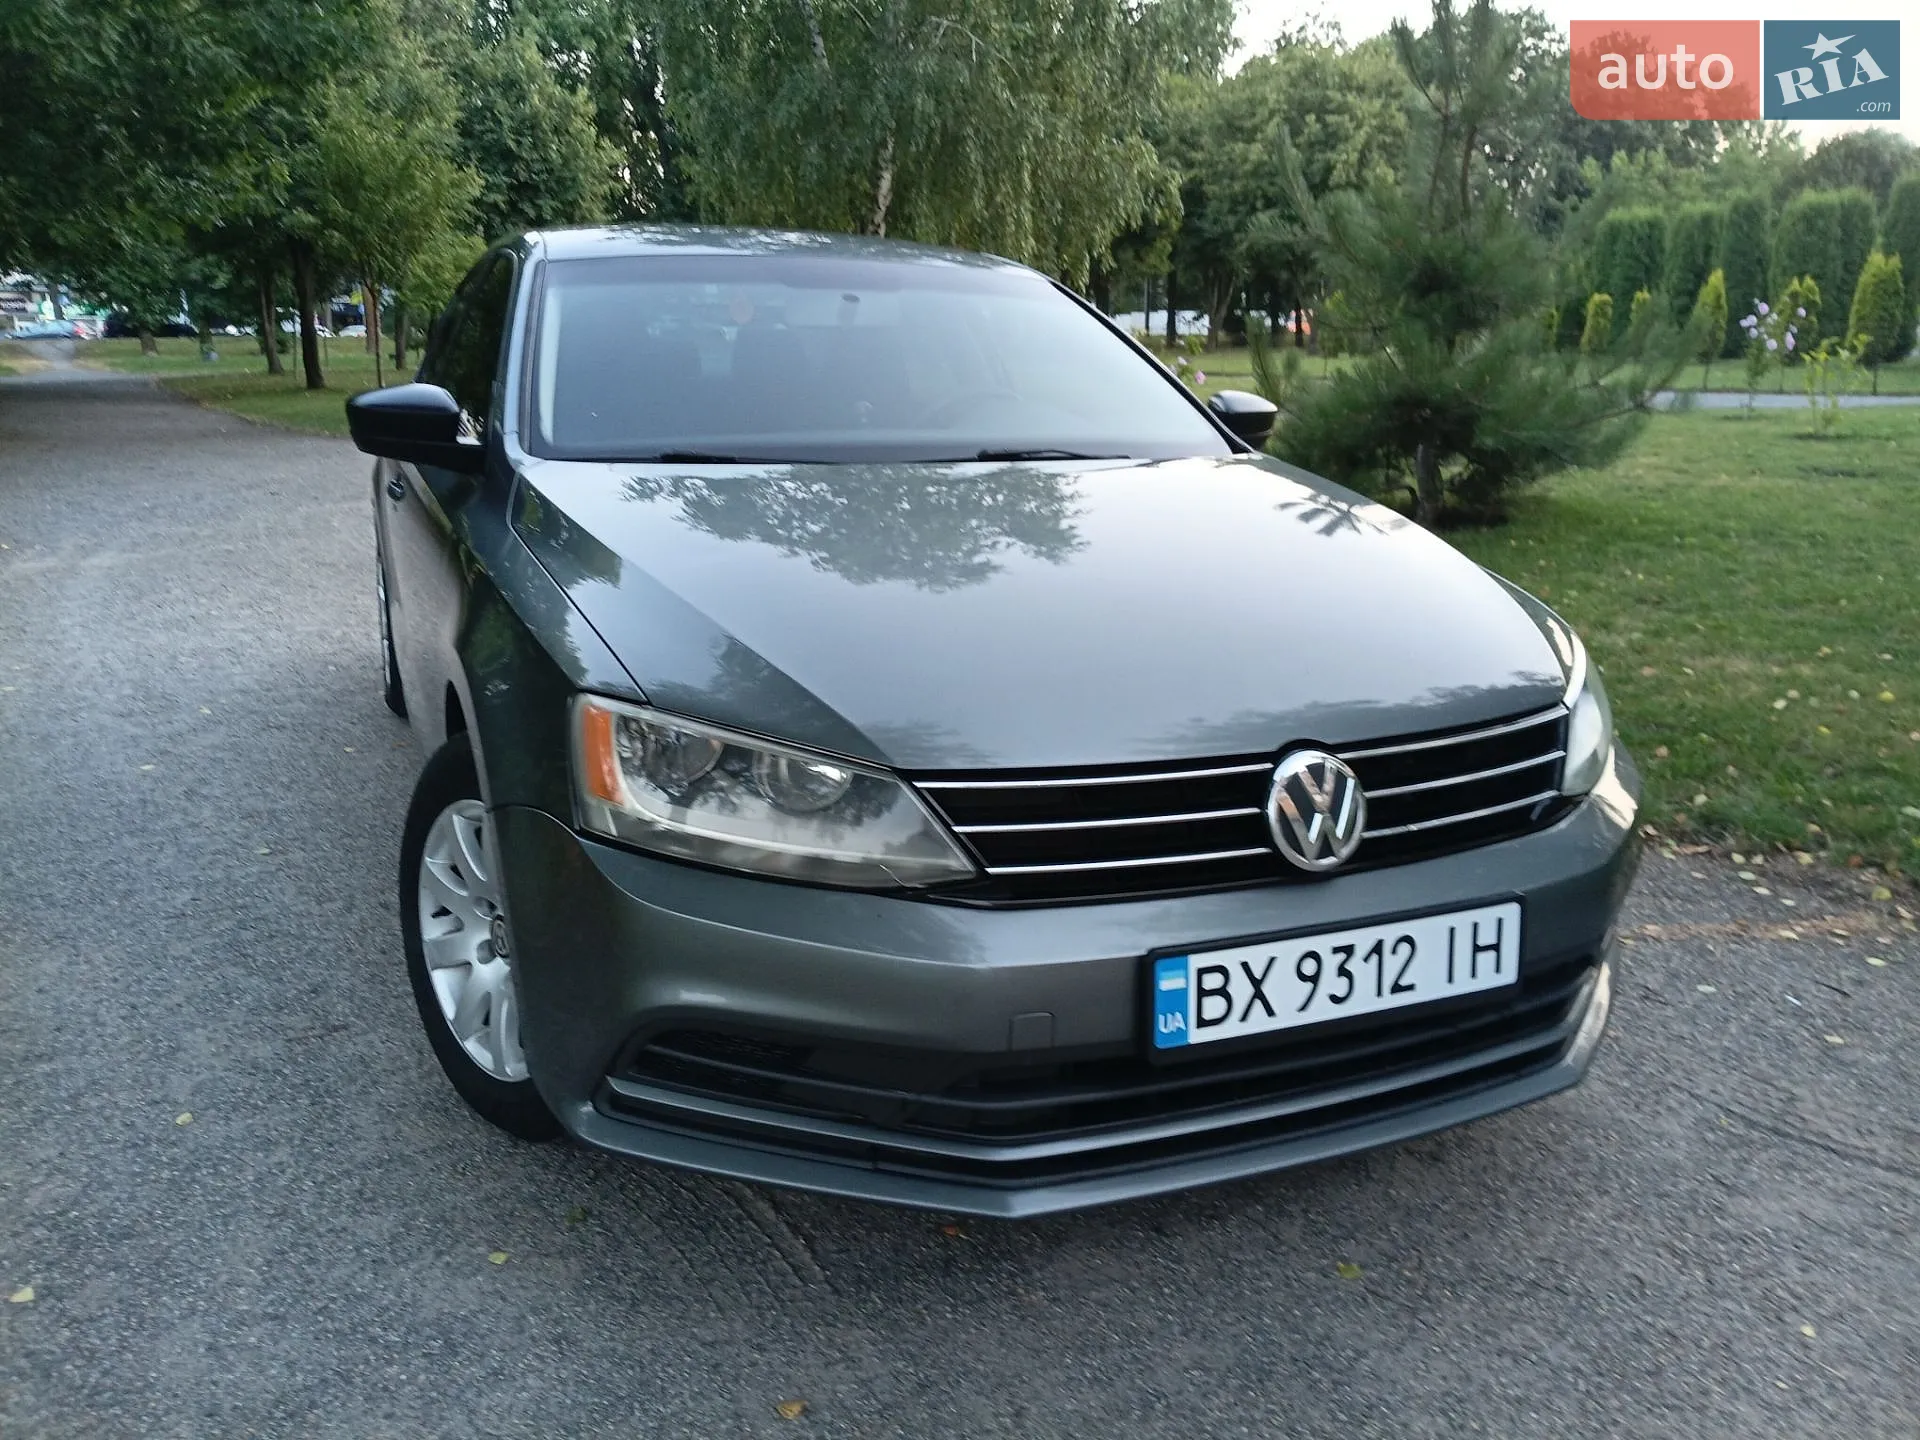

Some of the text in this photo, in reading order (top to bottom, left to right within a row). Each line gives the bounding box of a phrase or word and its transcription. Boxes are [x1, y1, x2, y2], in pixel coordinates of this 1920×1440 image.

[1196, 917, 1504, 1029] BX 9312 IH
[1158, 1011, 1187, 1034] UA
